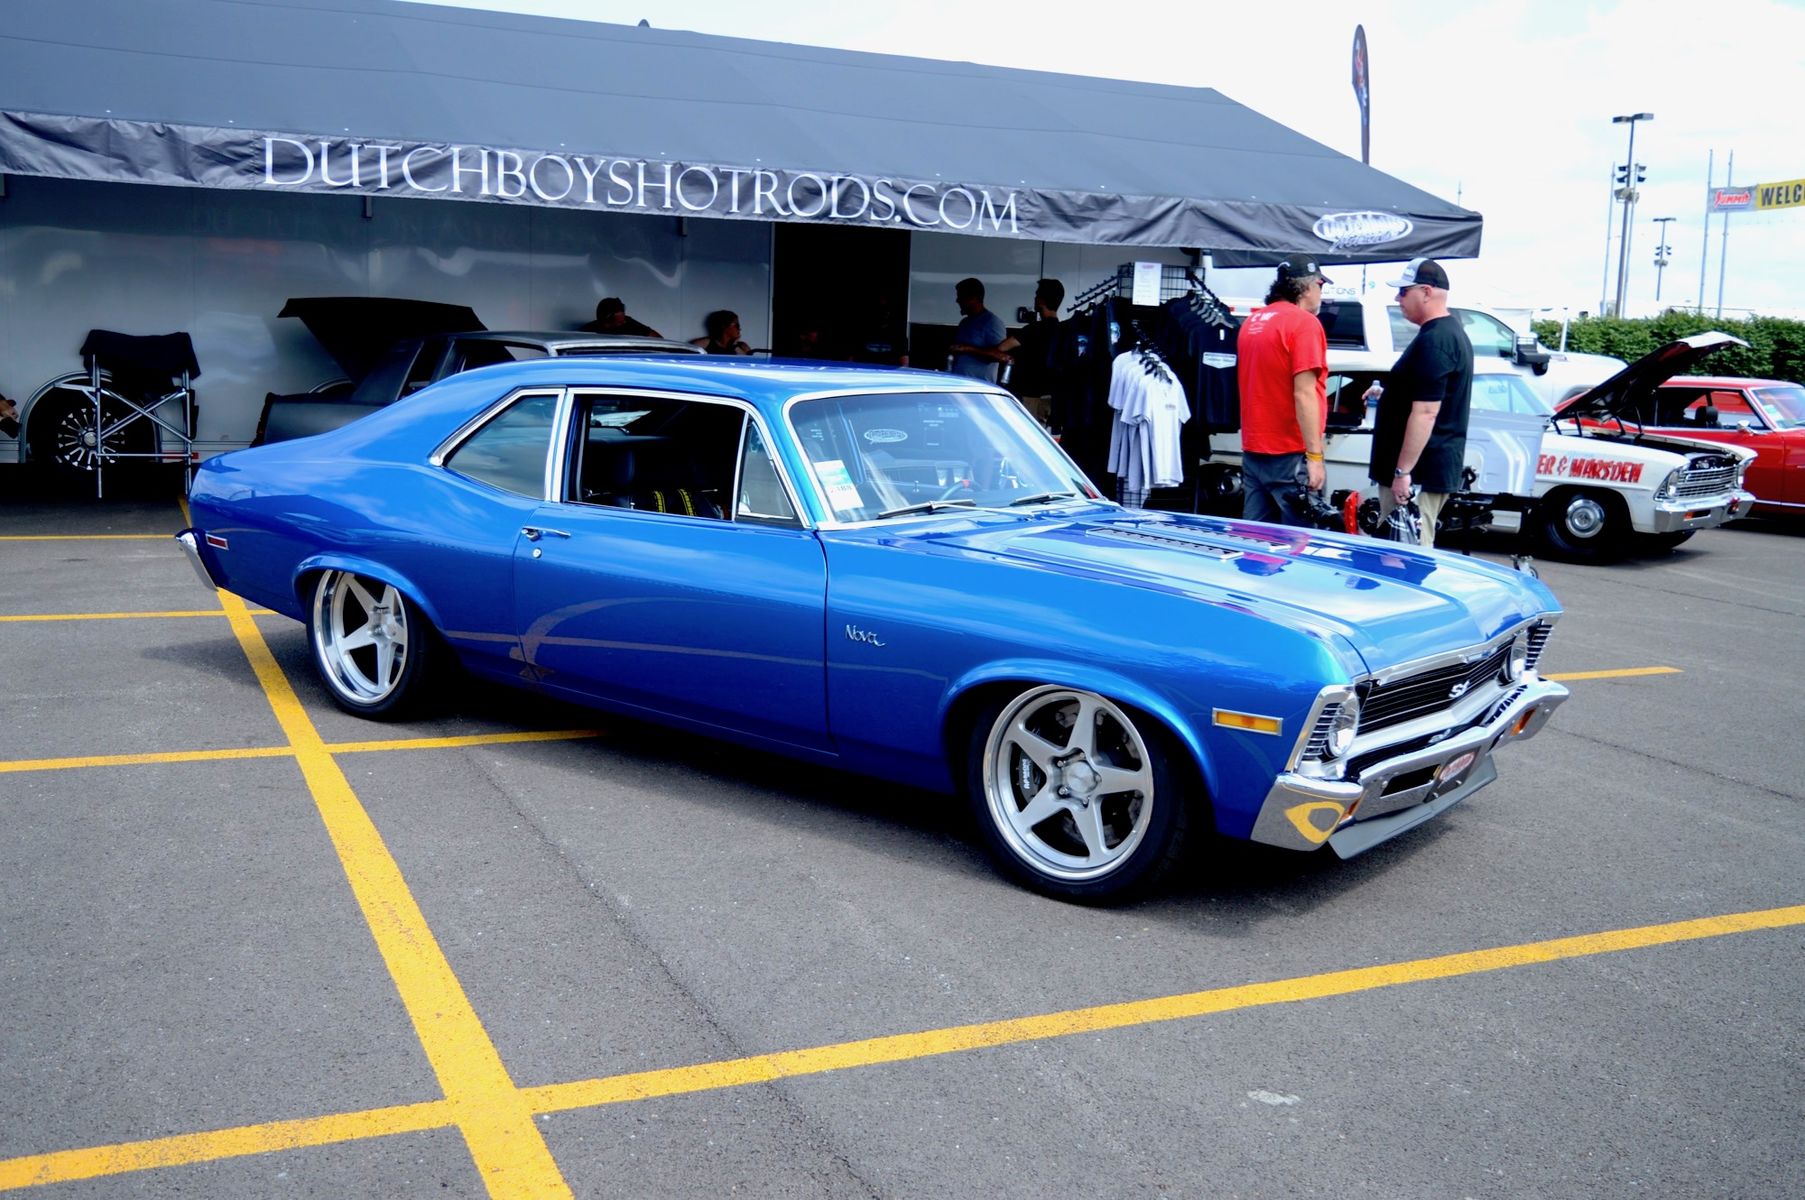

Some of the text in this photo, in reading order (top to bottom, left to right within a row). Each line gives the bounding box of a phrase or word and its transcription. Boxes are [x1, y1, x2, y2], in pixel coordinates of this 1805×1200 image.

[263, 137, 1020, 234] DUTCHBOYSHOTRODS.COM
[1761, 183, 1805, 206] WELC
[1557, 456, 1568, 476] &
[1569, 458, 1644, 483] MARSDEN
[845, 624, 886, 647] Nova
